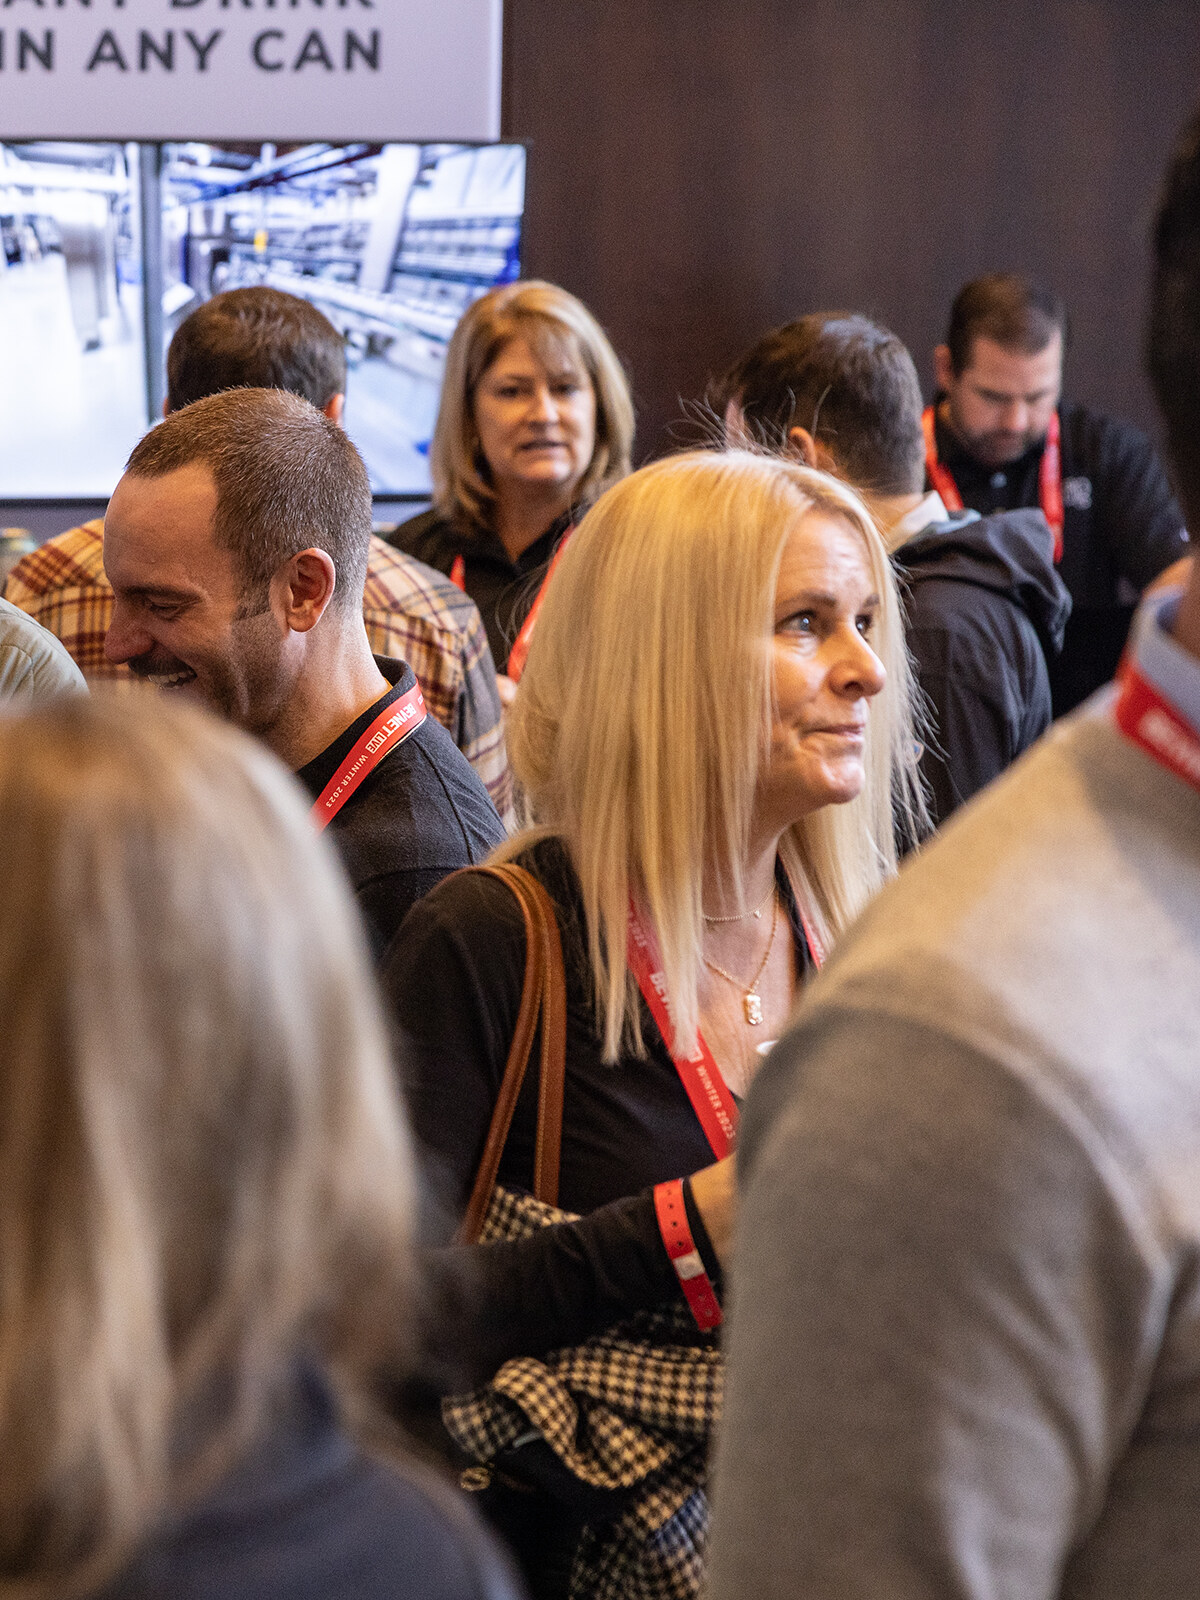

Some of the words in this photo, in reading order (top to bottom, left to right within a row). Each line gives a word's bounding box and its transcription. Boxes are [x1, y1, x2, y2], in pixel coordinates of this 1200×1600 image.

[86, 29, 224, 71] ANY
[251, 29, 381, 71] CAN
[381, 702, 417, 738] BEVNET
[365, 731, 388, 754] LIVE
[340, 754, 369, 787] WINTER
[325, 786, 344, 808] 2023
[697, 1064, 722, 1110] WINTER
[715, 1109, 736, 1140] 2023
